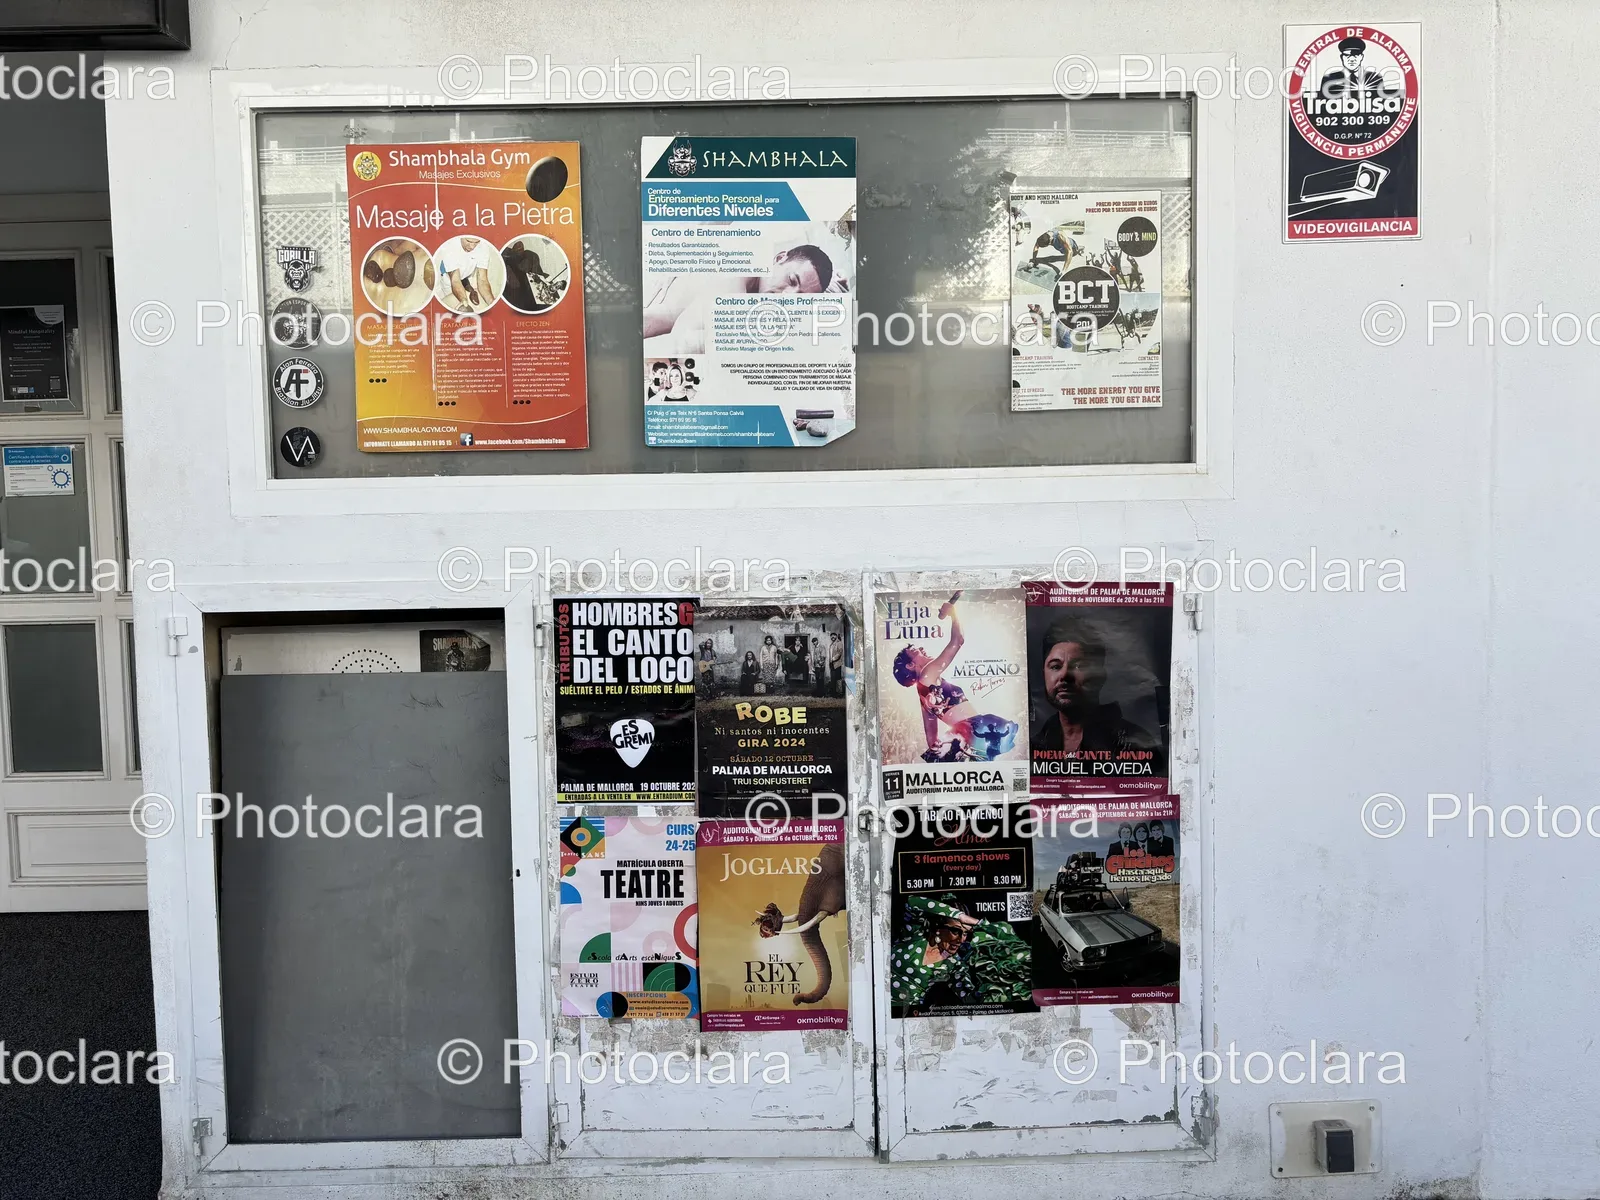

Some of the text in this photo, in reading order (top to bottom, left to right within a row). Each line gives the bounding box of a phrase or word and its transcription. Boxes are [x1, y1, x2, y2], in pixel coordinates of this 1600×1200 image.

[1347, 28, 1364, 38] DE
[1370, 31, 1413, 75] ALARMA
[1303, 91, 1401, 115] Trablisa
[1290, 97, 1417, 157] VIGILANCIA PERMANENTE
[1316, 115, 1391, 127] 902 300 309
[389, 149, 531, 170] Shambhala Gym
[702, 150, 848, 168] SHAMBHALA
[419, 169, 501, 180] Masajes Exclusivos
[648, 195, 780, 205] Entrenamiento Personal para
[648, 204, 774, 217] Diferentes Niveles
[356, 202, 574, 233] Masaje a la Pietra
[651, 228, 761, 237] Centro de Entrenamiento
[1293, 220, 1413, 235] VIDEOVIGILANCIA
[1118, 233, 1133, 242] BODY
[1141, 233, 1157, 242] MIND
[277, 249, 317, 262] GORILLA
[1057, 280, 1115, 304] BCT
[279, 359, 295, 373] Alan
[1061, 385, 1161, 396] THE MORE ENERGY YOU GIVE
[1073, 395, 1161, 405] THE MORE YOU GET BACK
[363, 426, 458, 435] WWW.SHAMBHALAGYM.COM
[887, 601, 932, 624] Hija
[883, 620, 944, 641] Luna
[558, 603, 570, 684] TRIBUTOS
[572, 628, 694, 656] EL CANTO
[573, 656, 694, 684] DEL LOCO
[952, 663, 1021, 677] MECANO
[560, 684, 593, 695] SUÉLTATE
[595, 686, 604, 695] EL
[605, 686, 623, 695] PELO
[631, 685, 662, 694] ESTADOS
[664, 685, 673, 694] DE
[674, 683, 696, 694] ÁNIM
[735, 702, 807, 726] ROBE
[622, 720, 639, 736] ES
[714, 726, 830, 736] Ni santos ni inocentes
[612, 732, 653, 750] GREMI
[737, 738, 806, 748] GIRA 2024
[729, 754, 763, 763] SÁBADO
[765, 755, 774, 763] 12
[1033, 750, 1153, 760] POEMA CANTE JONDO
[712, 764, 833, 775] PALMA DE MALLORCA
[1032, 762, 1088, 775] MIGUEL
[1093, 762, 1153, 775] POVEDA
[732, 777, 752, 786] TRUI
[884, 777, 899, 790] 11
[905, 770, 1004, 787] MALLORCA
[560, 783, 585, 792] PALMA
[586, 783, 596, 792] DE
[597, 782, 634, 792] MALLORCA
[640, 782, 649, 791] 19
[650, 782, 680, 791] OCTUBRE
[666, 824, 695, 836] CURS
[665, 839, 696, 852] 24-25
[616, 858, 684, 868] MATRÍCULA OBERTA
[914, 852, 1010, 864] 3 flamenco shows
[719, 852, 823, 882] JOGLARS
[600, 869, 685, 899] TEATRE
[907, 879, 934, 889] 5.30 PM
[948, 876, 977, 887] 7.30 PM
[993, 875, 1022, 885] 9.30 PM
[975, 902, 1006, 912] TICKETS
[768, 954, 783, 962] EL
[744, 960, 805, 984] REY
[744, 983, 801, 995] QUE FUE
